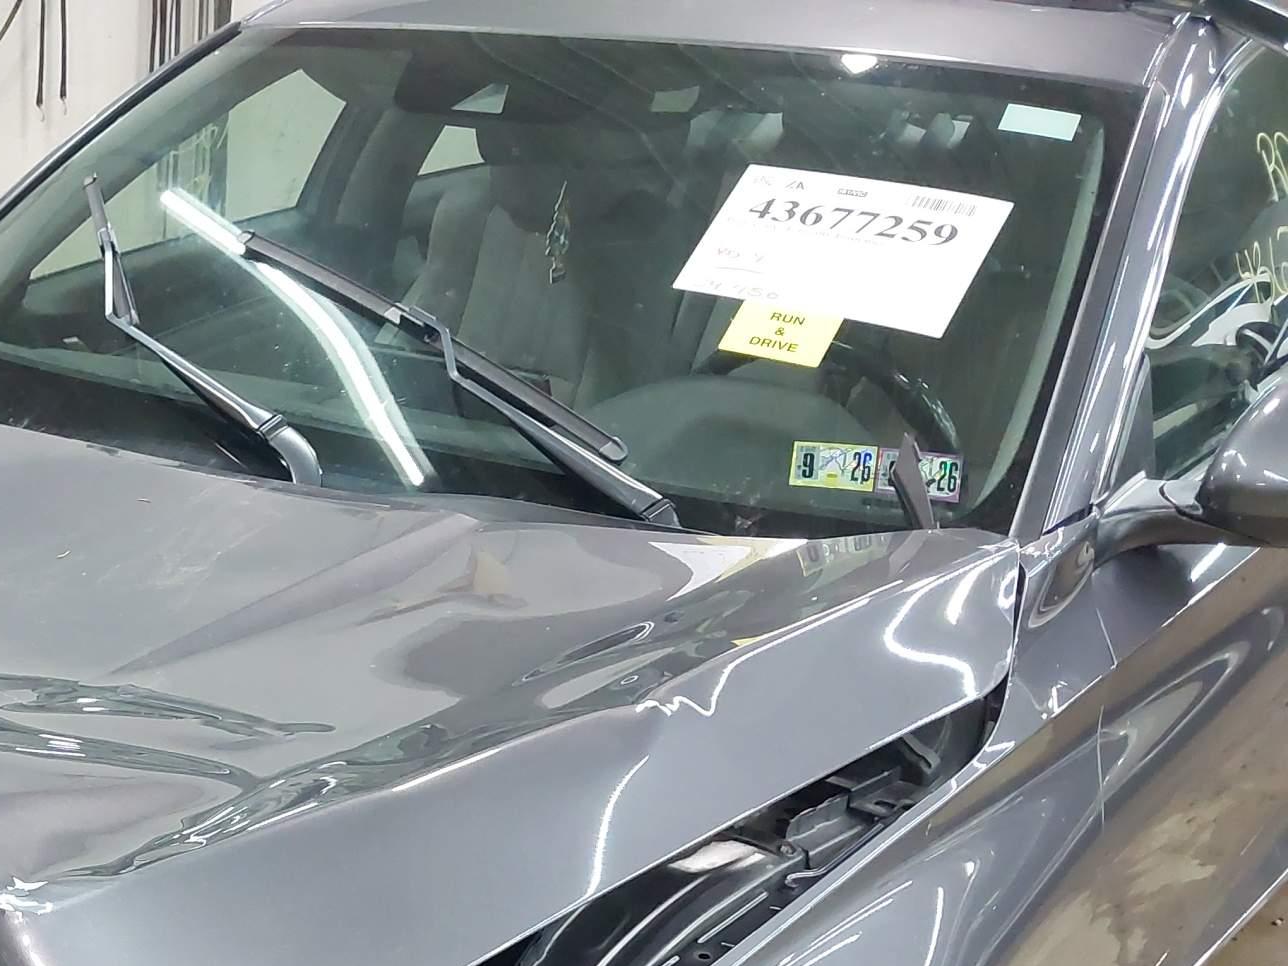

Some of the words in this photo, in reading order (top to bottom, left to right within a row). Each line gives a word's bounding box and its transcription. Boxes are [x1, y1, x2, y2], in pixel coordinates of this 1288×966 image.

[748, 198, 959, 246] 43677259
[770, 312, 806, 326] RUN
[749, 336, 799, 353] DRIVE
[774, 327, 785, 337] &
[801, 452, 815, 479] 9
[850, 451, 873, 484] 26
[937, 460, 959, 493] 26
